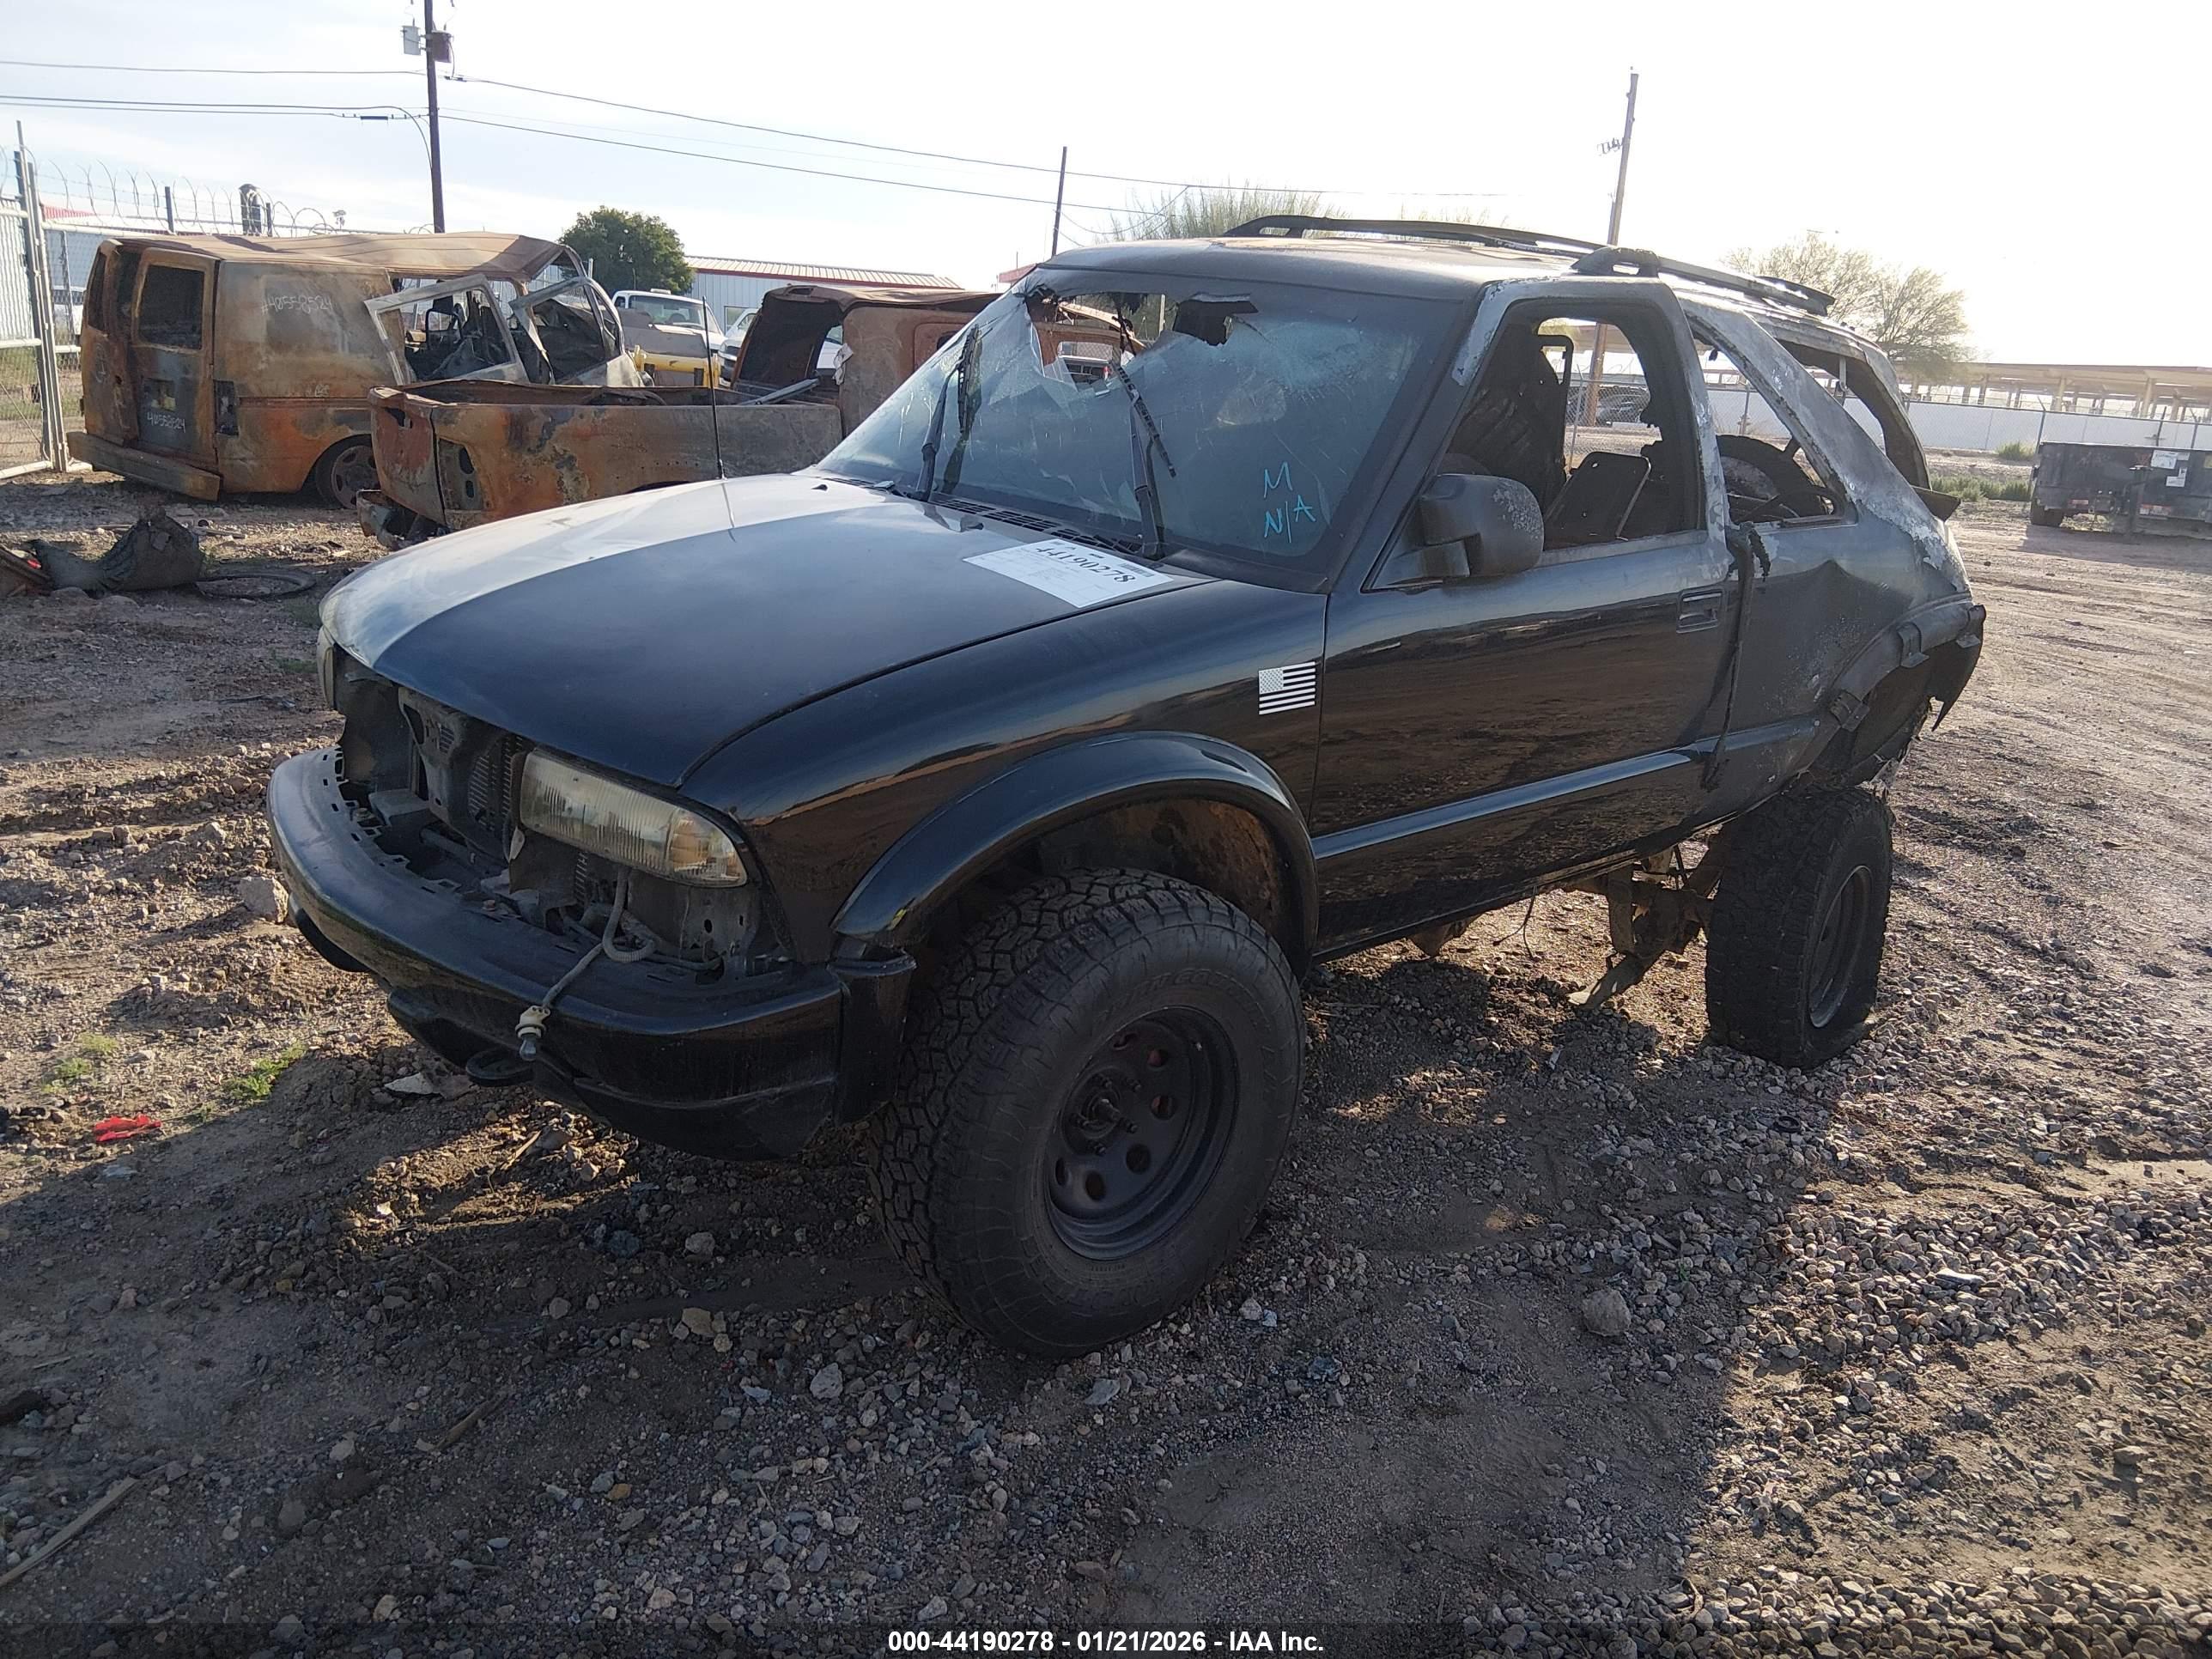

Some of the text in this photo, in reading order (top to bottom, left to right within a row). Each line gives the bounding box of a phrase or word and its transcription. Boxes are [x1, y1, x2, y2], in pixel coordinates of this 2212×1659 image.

[1263, 461, 1293, 499] M
[1263, 494, 1317, 543] N/A
[1036, 547, 1136, 583] 44190278
